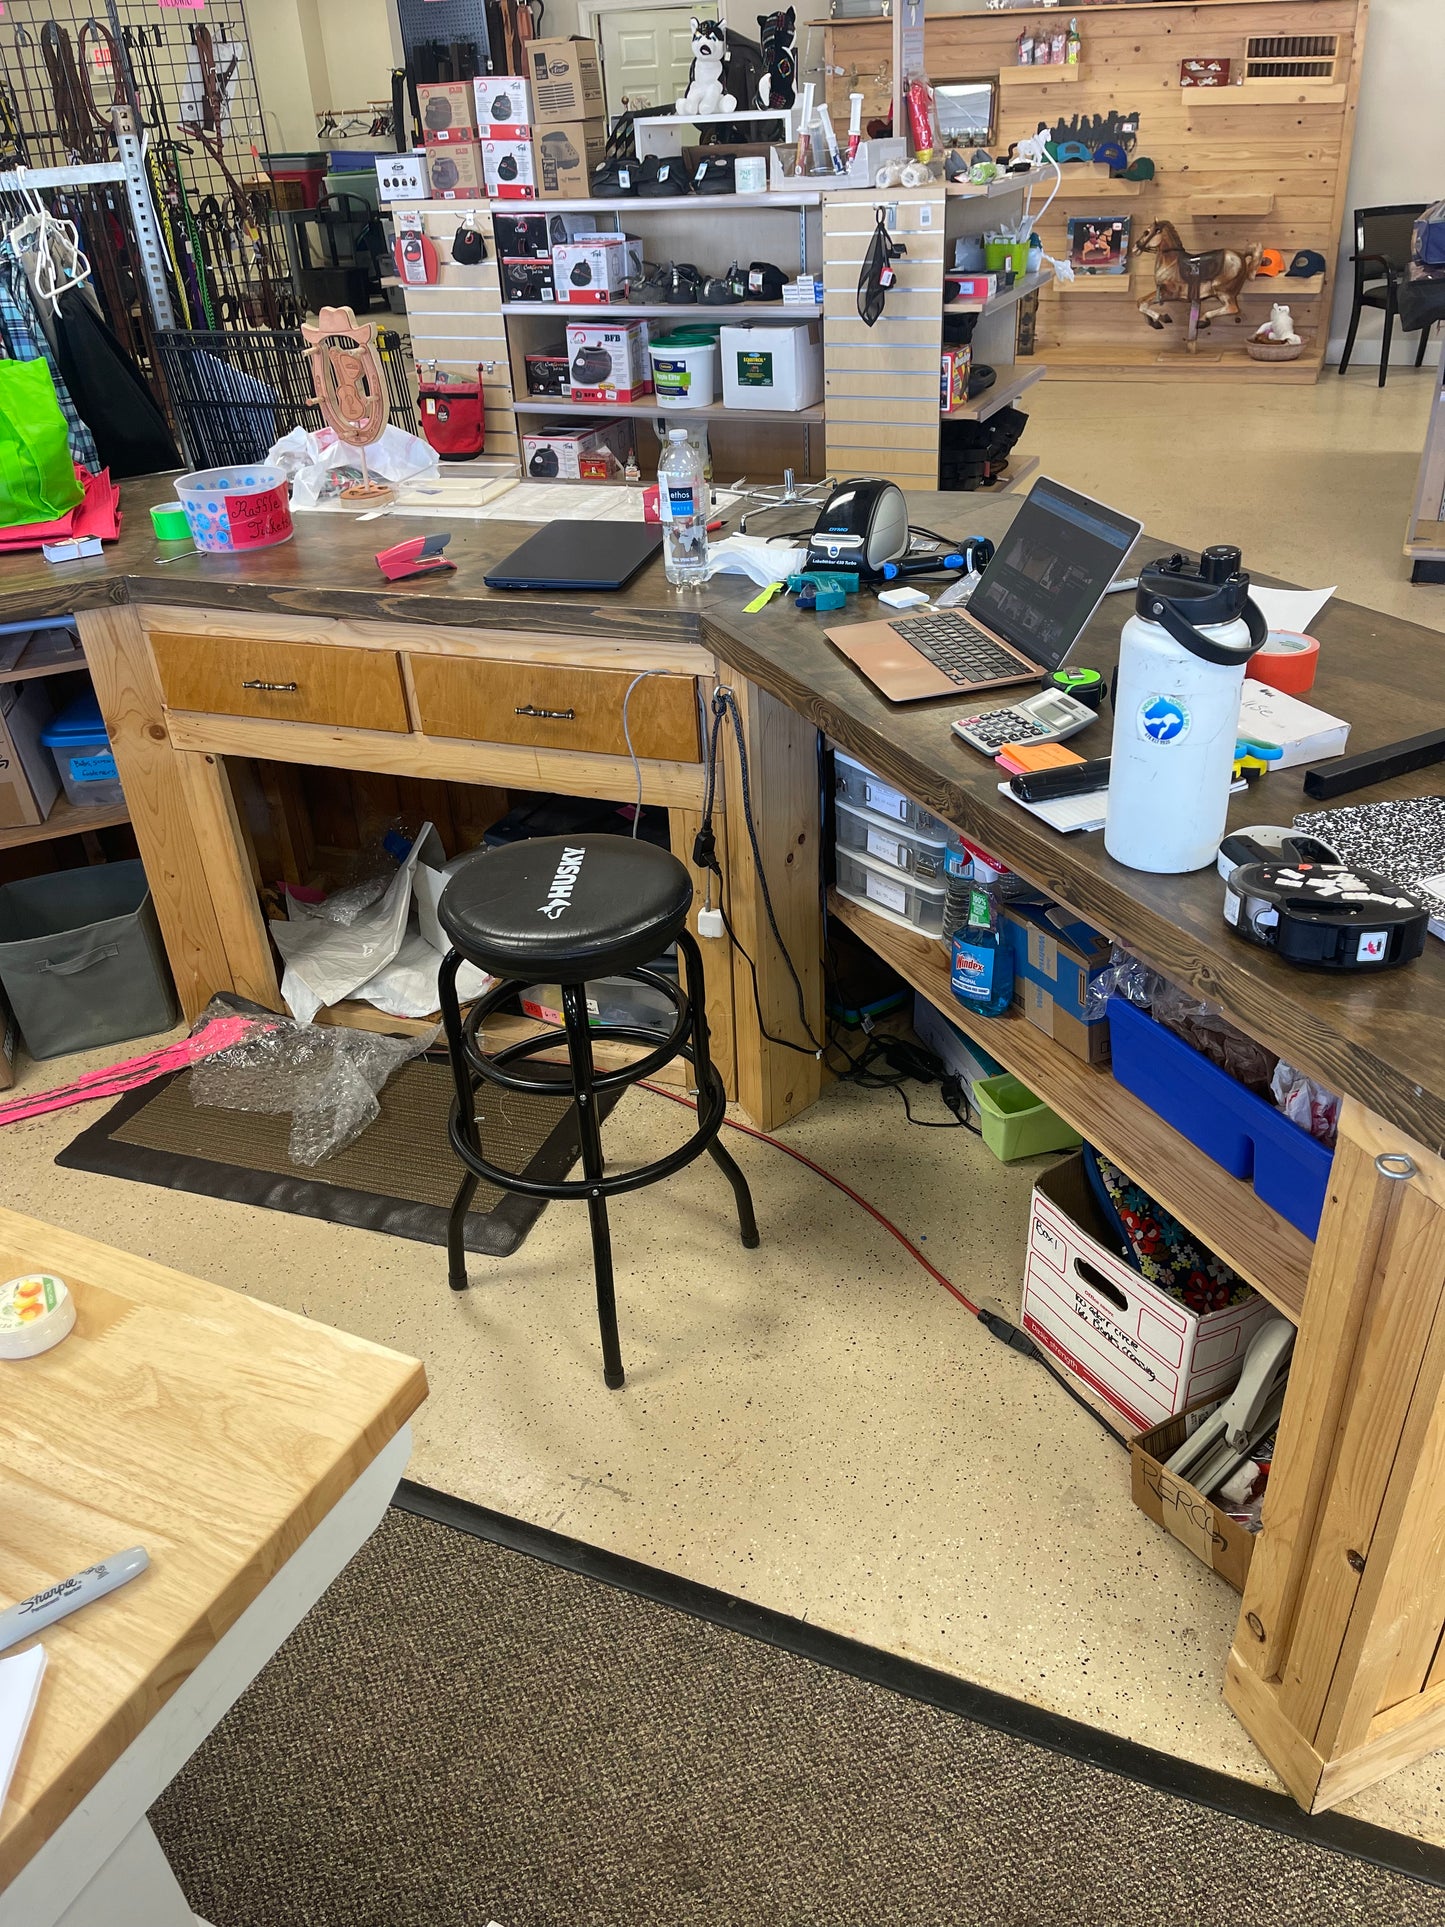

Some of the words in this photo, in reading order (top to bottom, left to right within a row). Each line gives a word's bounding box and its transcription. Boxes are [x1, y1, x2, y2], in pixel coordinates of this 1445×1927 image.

[604, 334, 621, 342] BFB
[231, 494, 280, 518] Raffle
[670, 491, 690, 500] ethos
[248, 516, 291, 539] Tickets
[547, 847, 587, 899] HUSKY
[956, 953, 985, 971] Windex
[1036, 1220, 1054, 1243] Box
[1031, 1322, 1050, 1345] basic
[1049, 1342, 1079, 1372] strength
[18, 1577, 78, 1615] Sharpie
